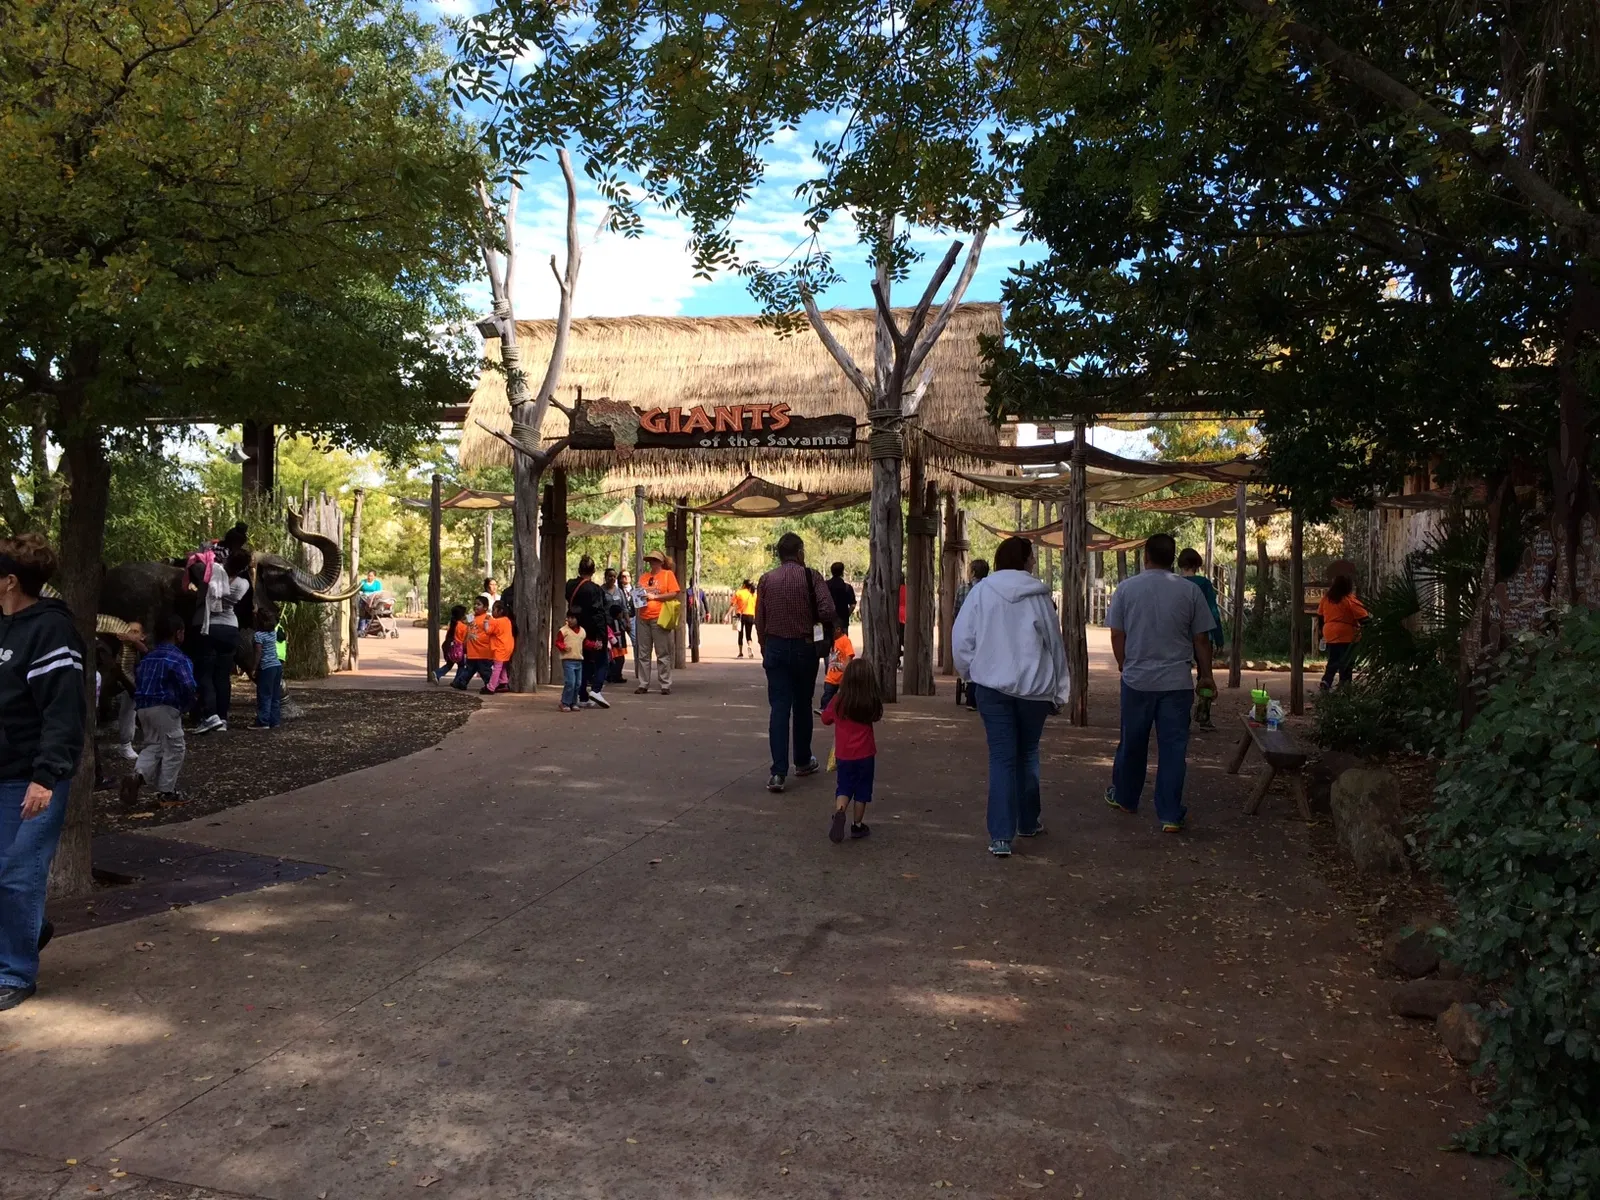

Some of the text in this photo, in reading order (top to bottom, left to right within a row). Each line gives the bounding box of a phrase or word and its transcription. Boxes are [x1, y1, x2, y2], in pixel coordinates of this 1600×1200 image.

[640, 403, 791, 434] GIANTS
[700, 434, 849, 447] of the Savanna
